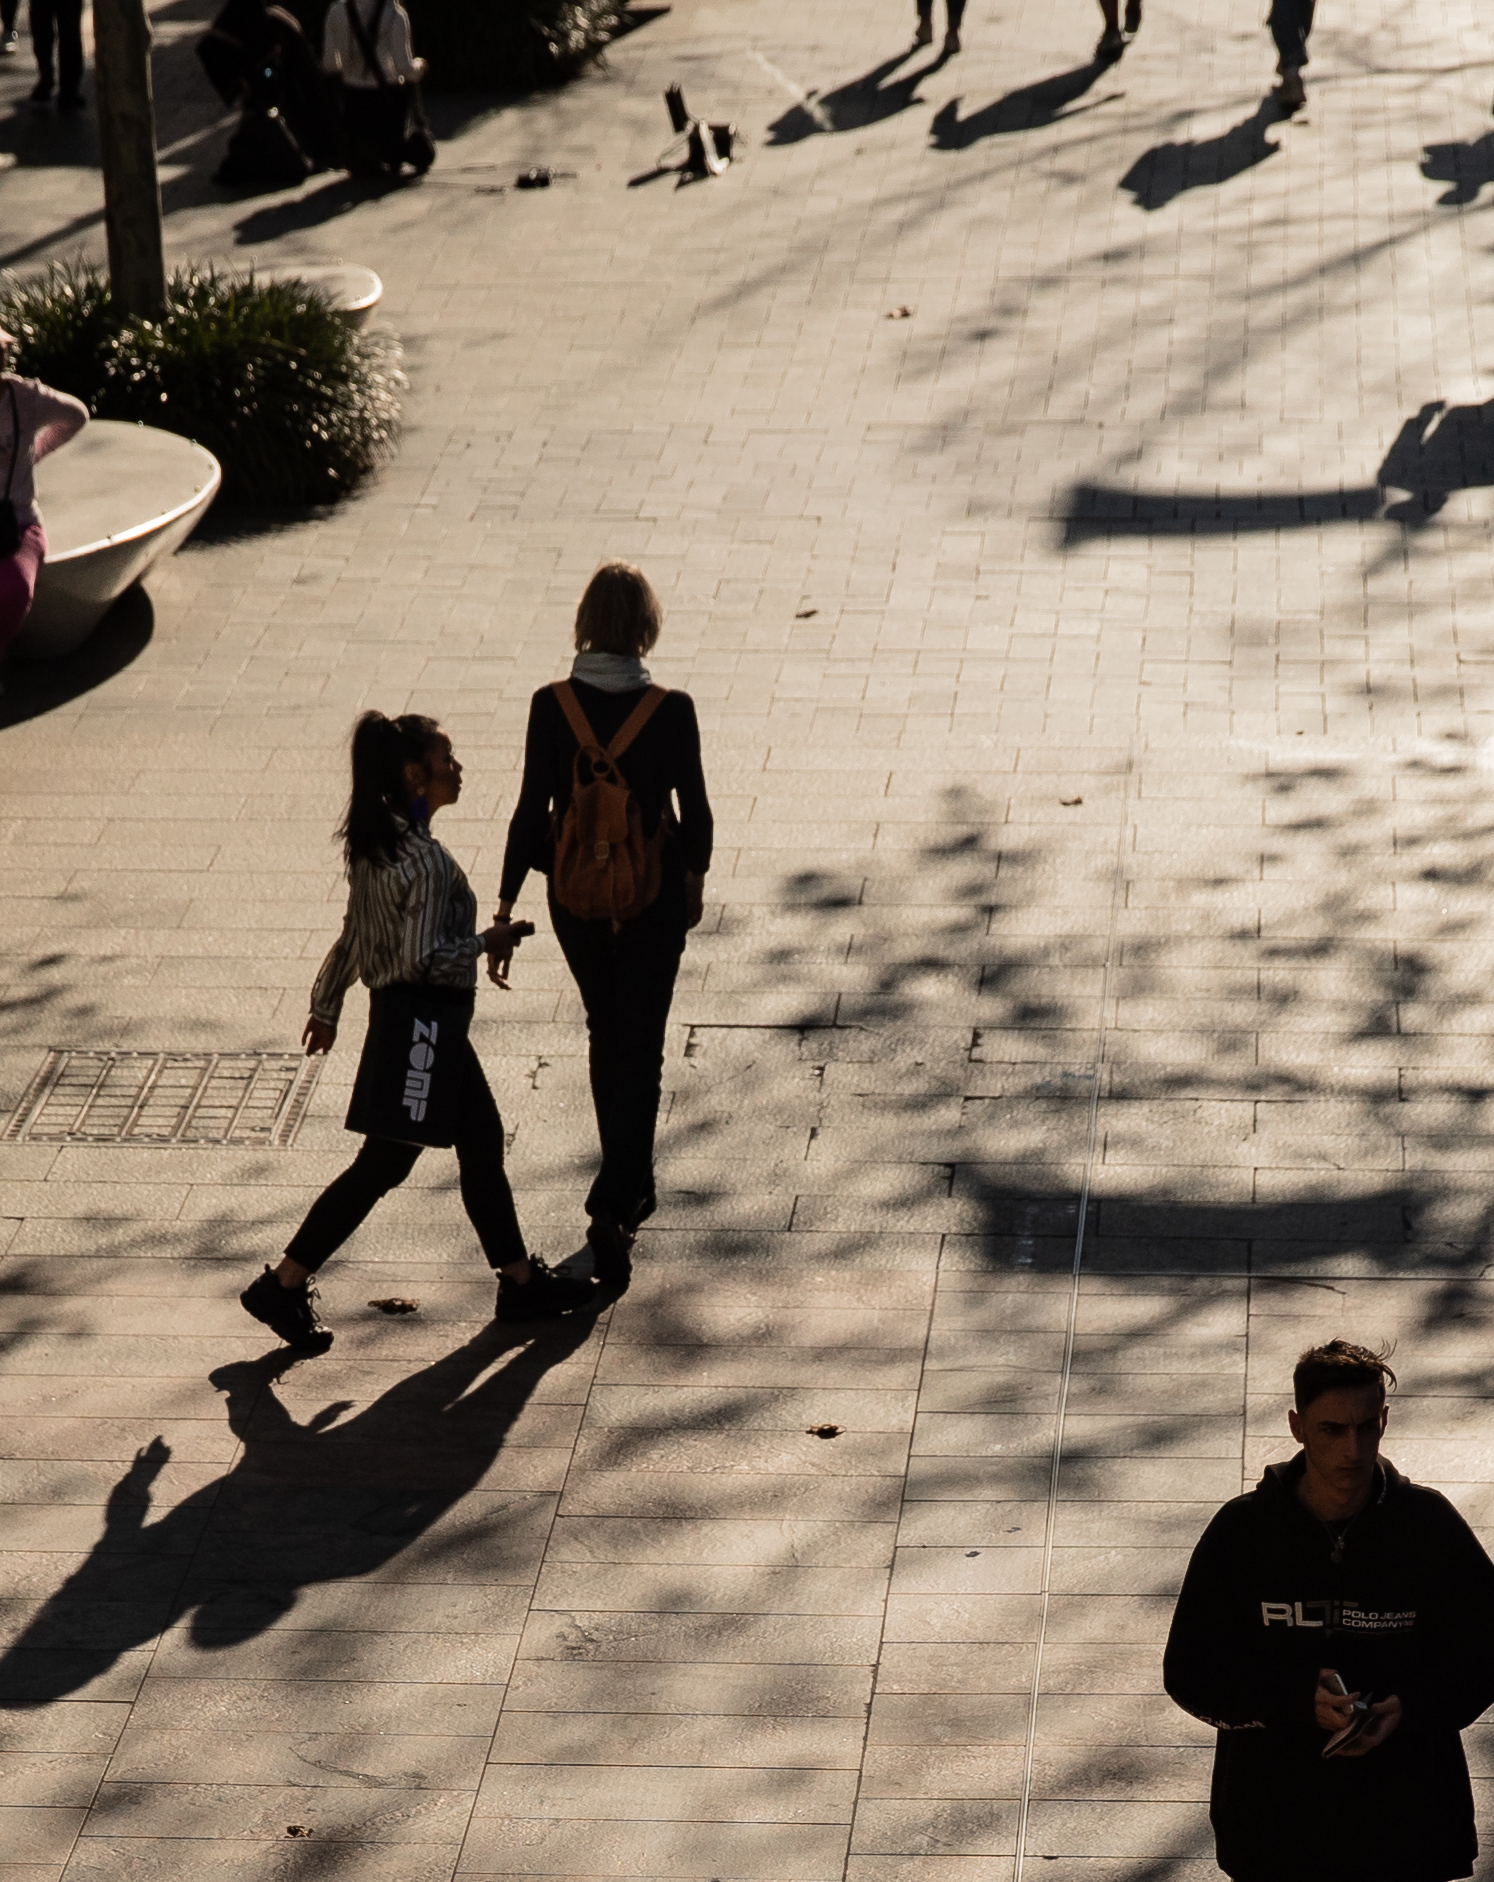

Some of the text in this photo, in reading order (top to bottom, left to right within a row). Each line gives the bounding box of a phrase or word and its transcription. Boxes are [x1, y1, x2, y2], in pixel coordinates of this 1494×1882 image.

[1342, 1609, 1417, 1620] POLO JEANS
[1342, 1618, 1404, 1629] COMPANY
